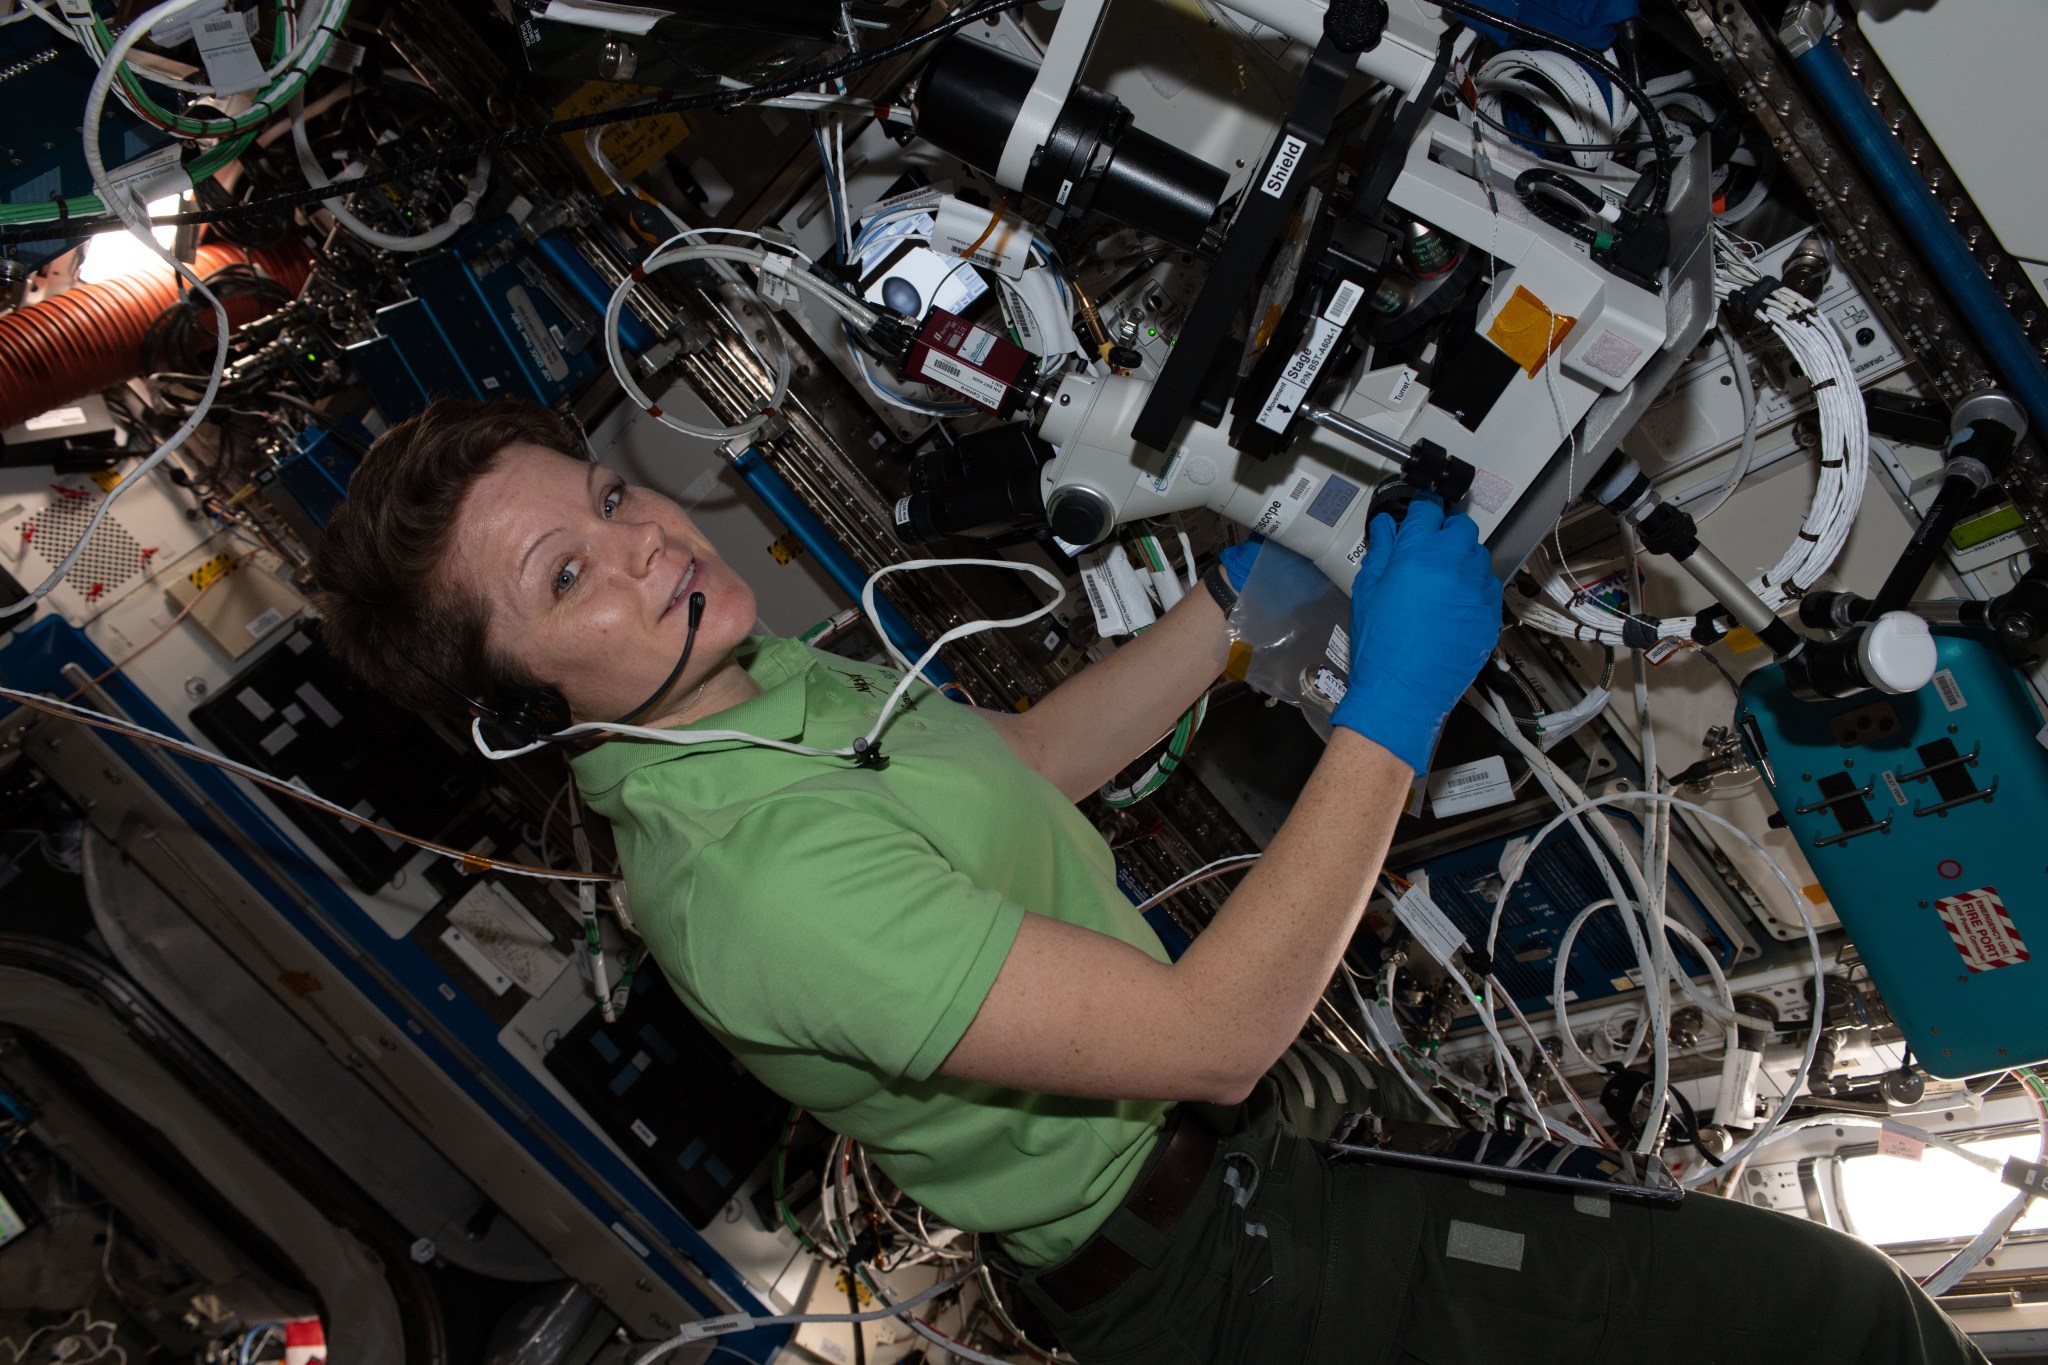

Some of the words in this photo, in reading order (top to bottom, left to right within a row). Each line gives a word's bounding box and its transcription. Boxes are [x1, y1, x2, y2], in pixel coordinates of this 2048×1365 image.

[1266, 140, 1301, 193] Shield
[1287, 346, 1314, 381] Stage
[1300, 371, 1313, 386] P/N
[1308, 327, 1338, 372] BST-A604-1
[960, 385, 981, 398] Camera
[1260, 411, 1270, 424] X-Y
[1266, 381, 1287, 413] Movement
[1394, 381, 1411, 402] Turret
[1316, 486, 1334, 508] Nikon
[1650, 641, 1672, 659] Adapter
[1959, 917, 1972, 936] Power
[1969, 935, 1987, 962] Converter
[1962, 901, 1982, 929] FIRE
[1976, 927, 1999, 961] PORT
[1976, 899, 2002, 941] EMERGENCY
[1998, 940, 2009, 956] USE
